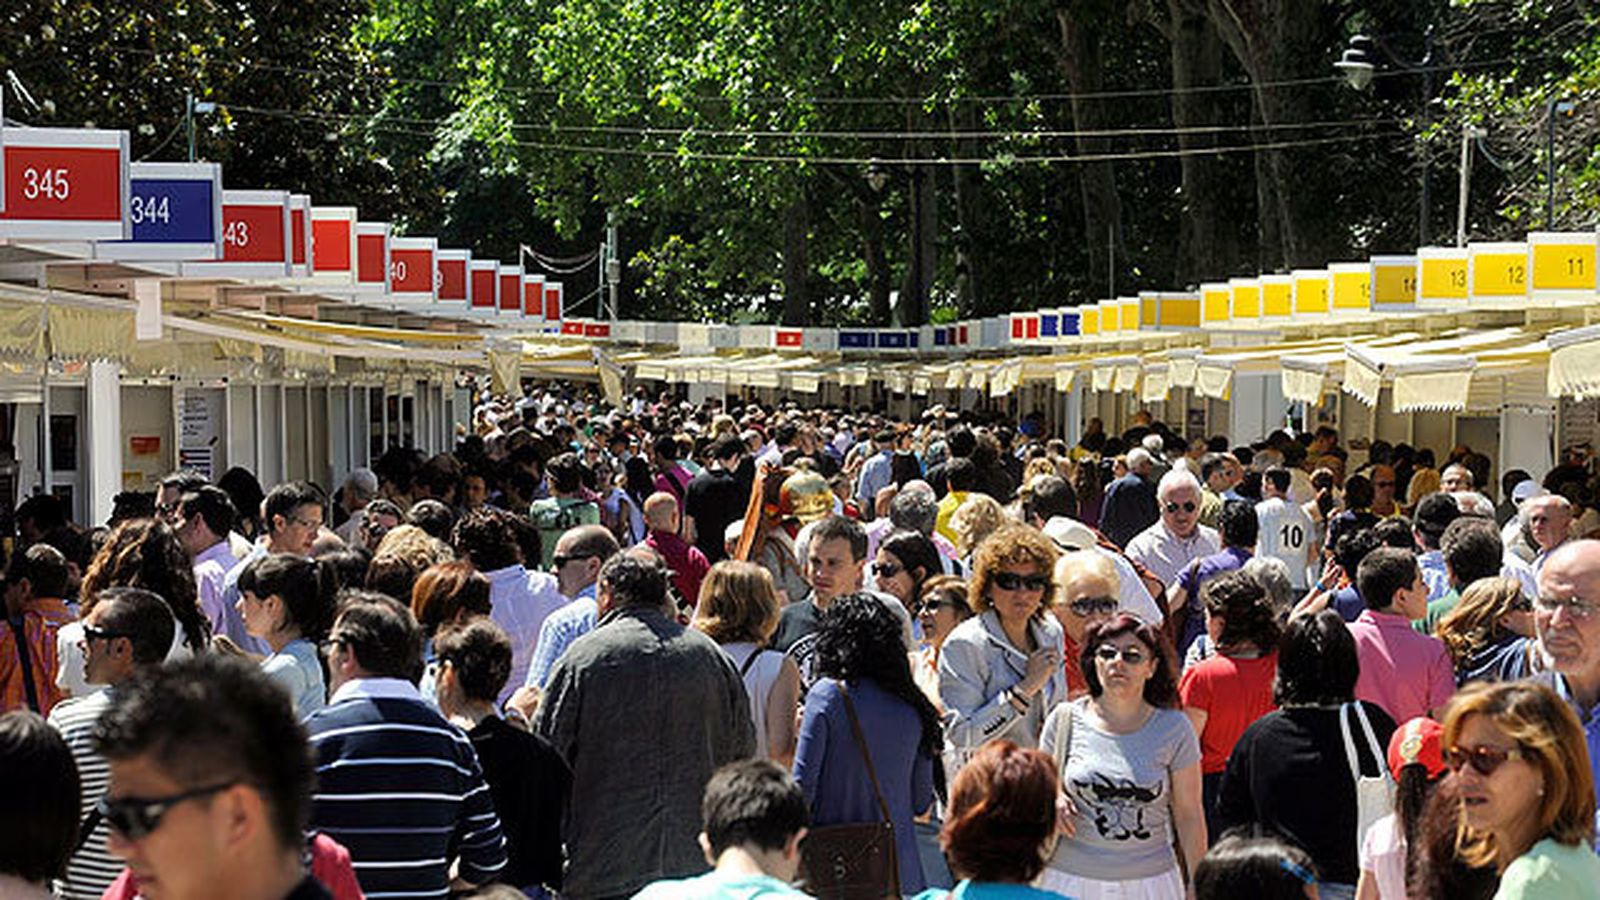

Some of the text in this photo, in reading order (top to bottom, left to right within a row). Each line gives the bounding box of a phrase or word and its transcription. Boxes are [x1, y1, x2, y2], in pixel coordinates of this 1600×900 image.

[23, 167, 69, 200] 345
[131, 196, 170, 223] 344
[1508, 265, 1524, 284] 12
[1568, 258, 1583, 275] 11
[1451, 269, 1466, 288] 13
[1280, 524, 1303, 549] 10
